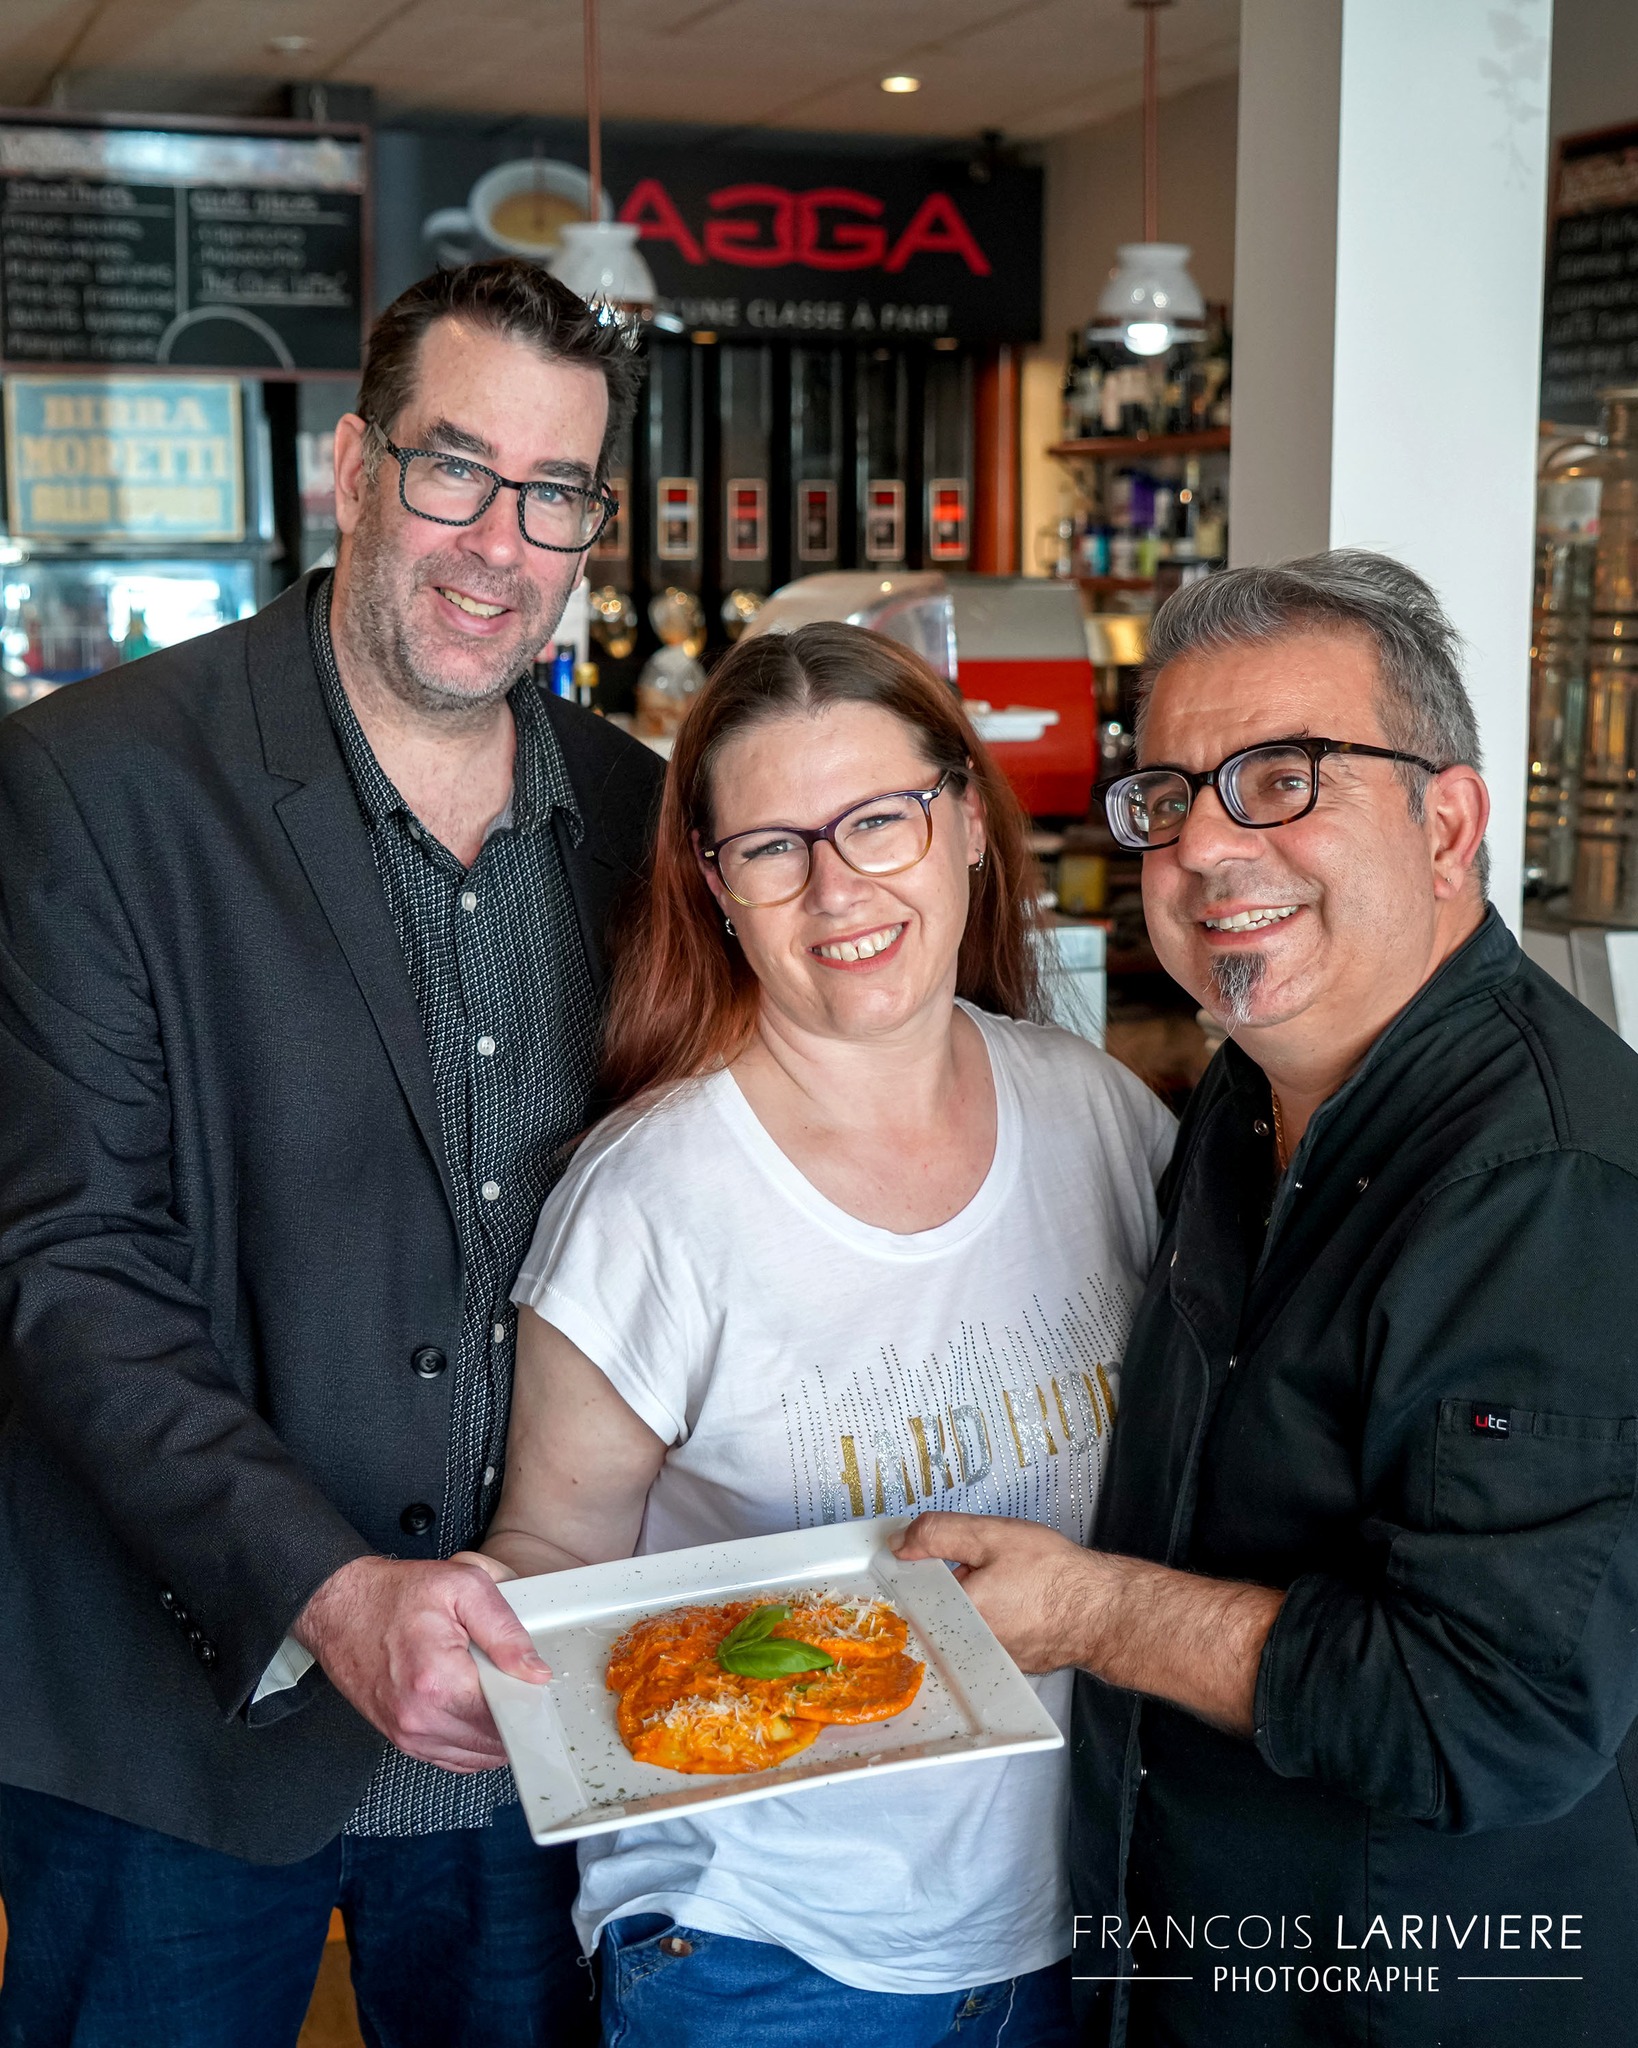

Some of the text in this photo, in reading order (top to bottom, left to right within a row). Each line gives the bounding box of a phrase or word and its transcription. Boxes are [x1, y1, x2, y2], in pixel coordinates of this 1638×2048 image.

[747, 299, 845, 329] CLASSE
[853, 298, 874, 331] À
[881, 304, 949, 332] PART
[43, 395, 209, 430] BIRRA
[20, 436, 226, 479] MORETTI
[1475, 1413, 1508, 1432] utc
